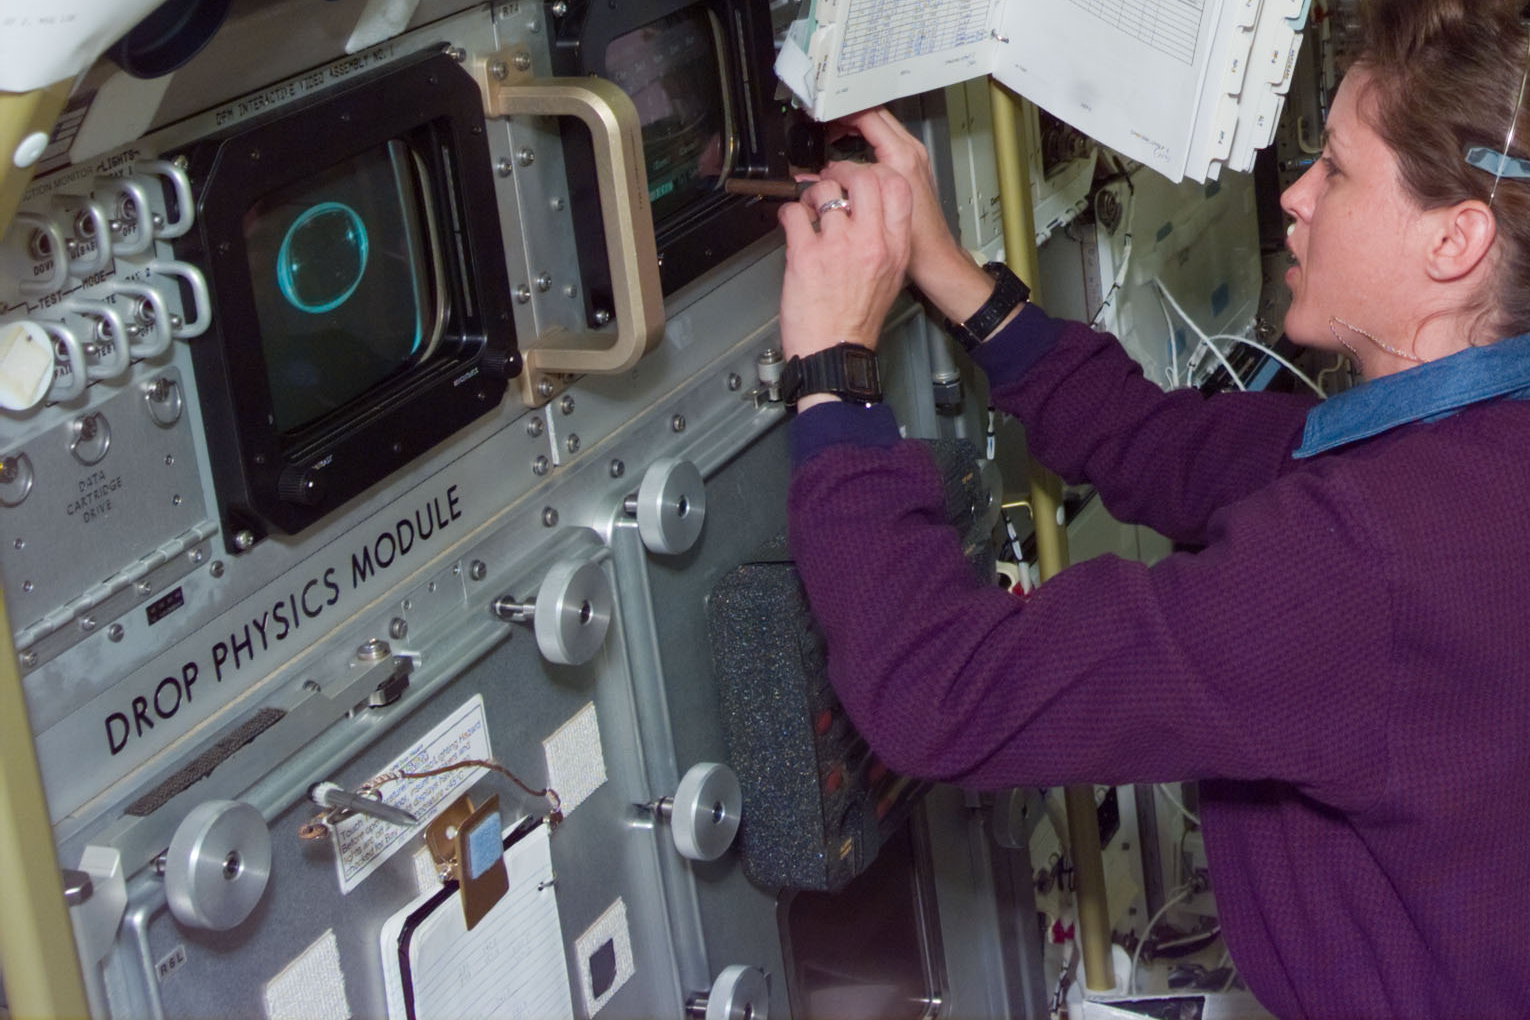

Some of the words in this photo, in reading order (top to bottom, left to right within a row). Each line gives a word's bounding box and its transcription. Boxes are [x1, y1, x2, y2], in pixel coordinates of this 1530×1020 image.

[238, 82, 296, 119] INTERACTIVE
[299, 70, 326, 97] VIDEO
[327, 55, 370, 83] ASSEMBLY
[101, 149, 135, 172] LIGHTS
[54, 167, 93, 189] MONITOR
[122, 223, 137, 237] OFF
[82, 270, 106, 290] MODE
[38, 290, 62, 309] TEST
[140, 323, 154, 337] OFF
[78, 470, 106, 493] DATA
[66, 476, 123, 517] CARTRIDGE
[82, 499, 113, 524] DRIVE
[105, 662, 198, 756] DROP
[212, 567, 340, 682] PHYSICS
[352, 484, 462, 588] MODULE
